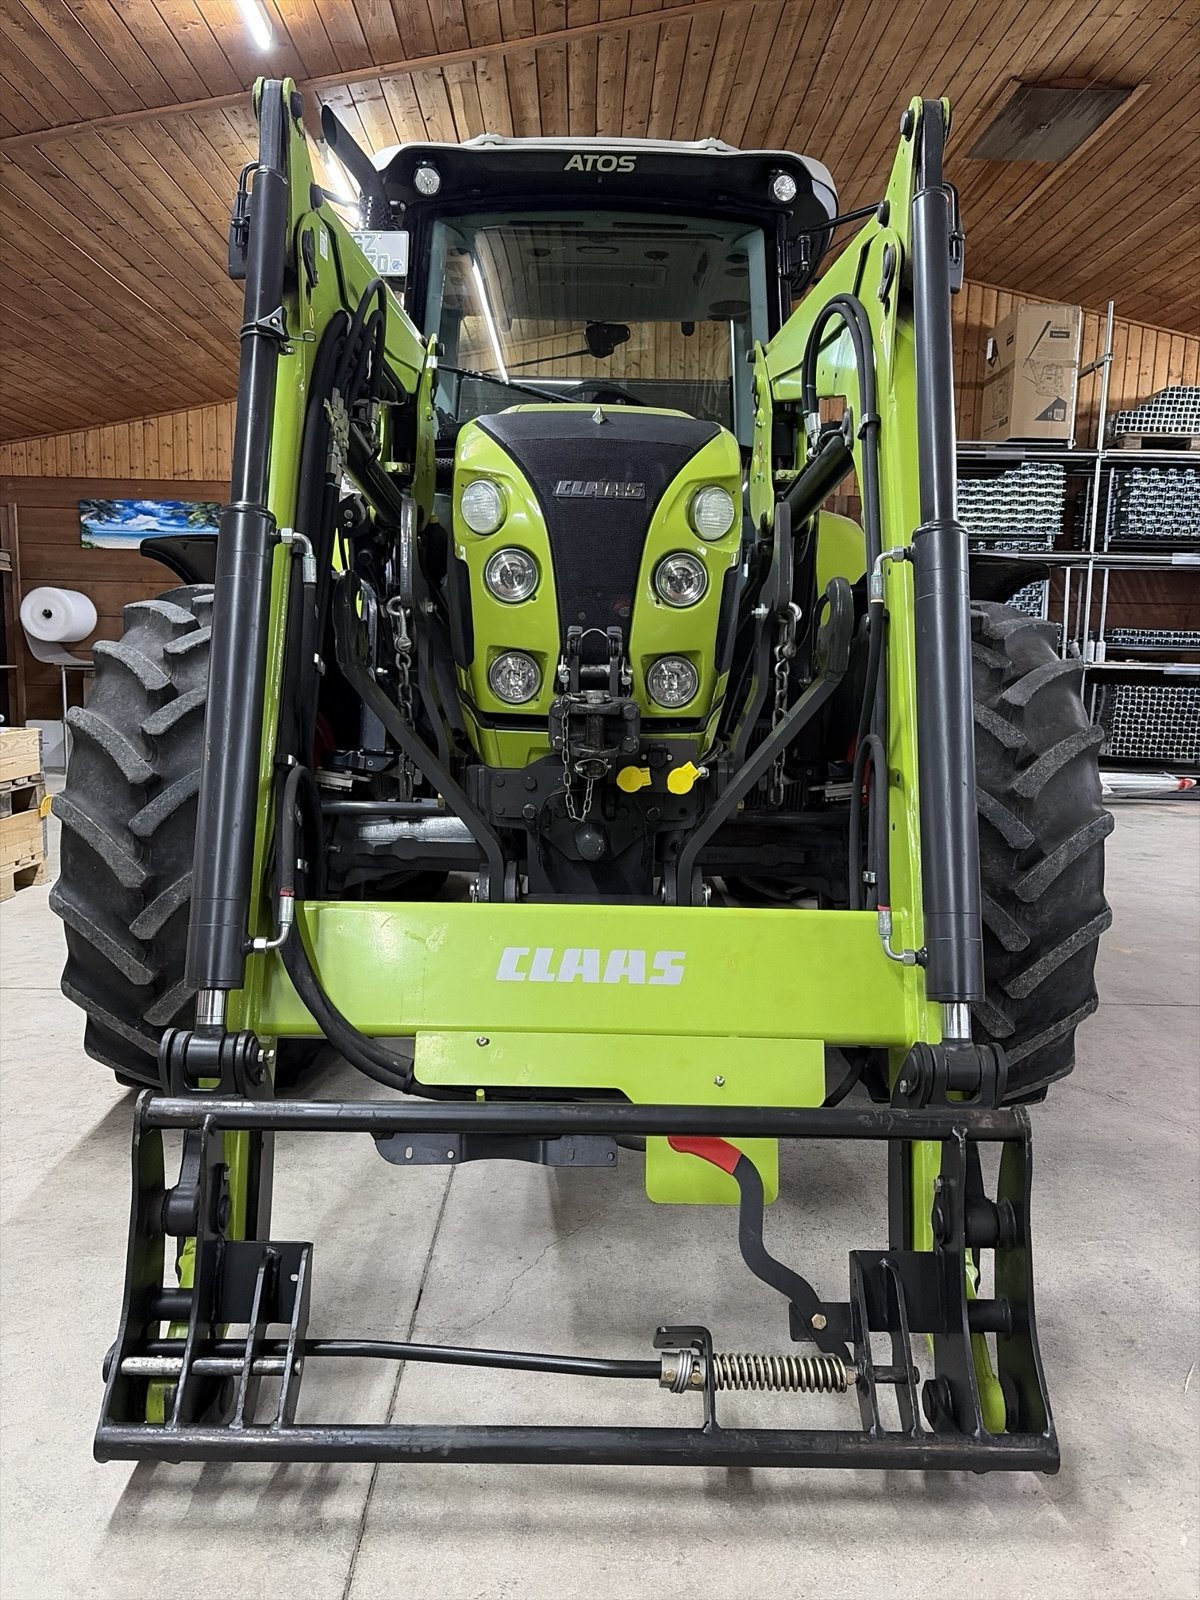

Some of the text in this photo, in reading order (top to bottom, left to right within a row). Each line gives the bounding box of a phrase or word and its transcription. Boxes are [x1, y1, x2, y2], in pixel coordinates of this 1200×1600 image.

[563, 154, 638, 173] ATOS
[553, 480, 645, 498] CLAAS
[496, 947, 687, 985] CLAAS
